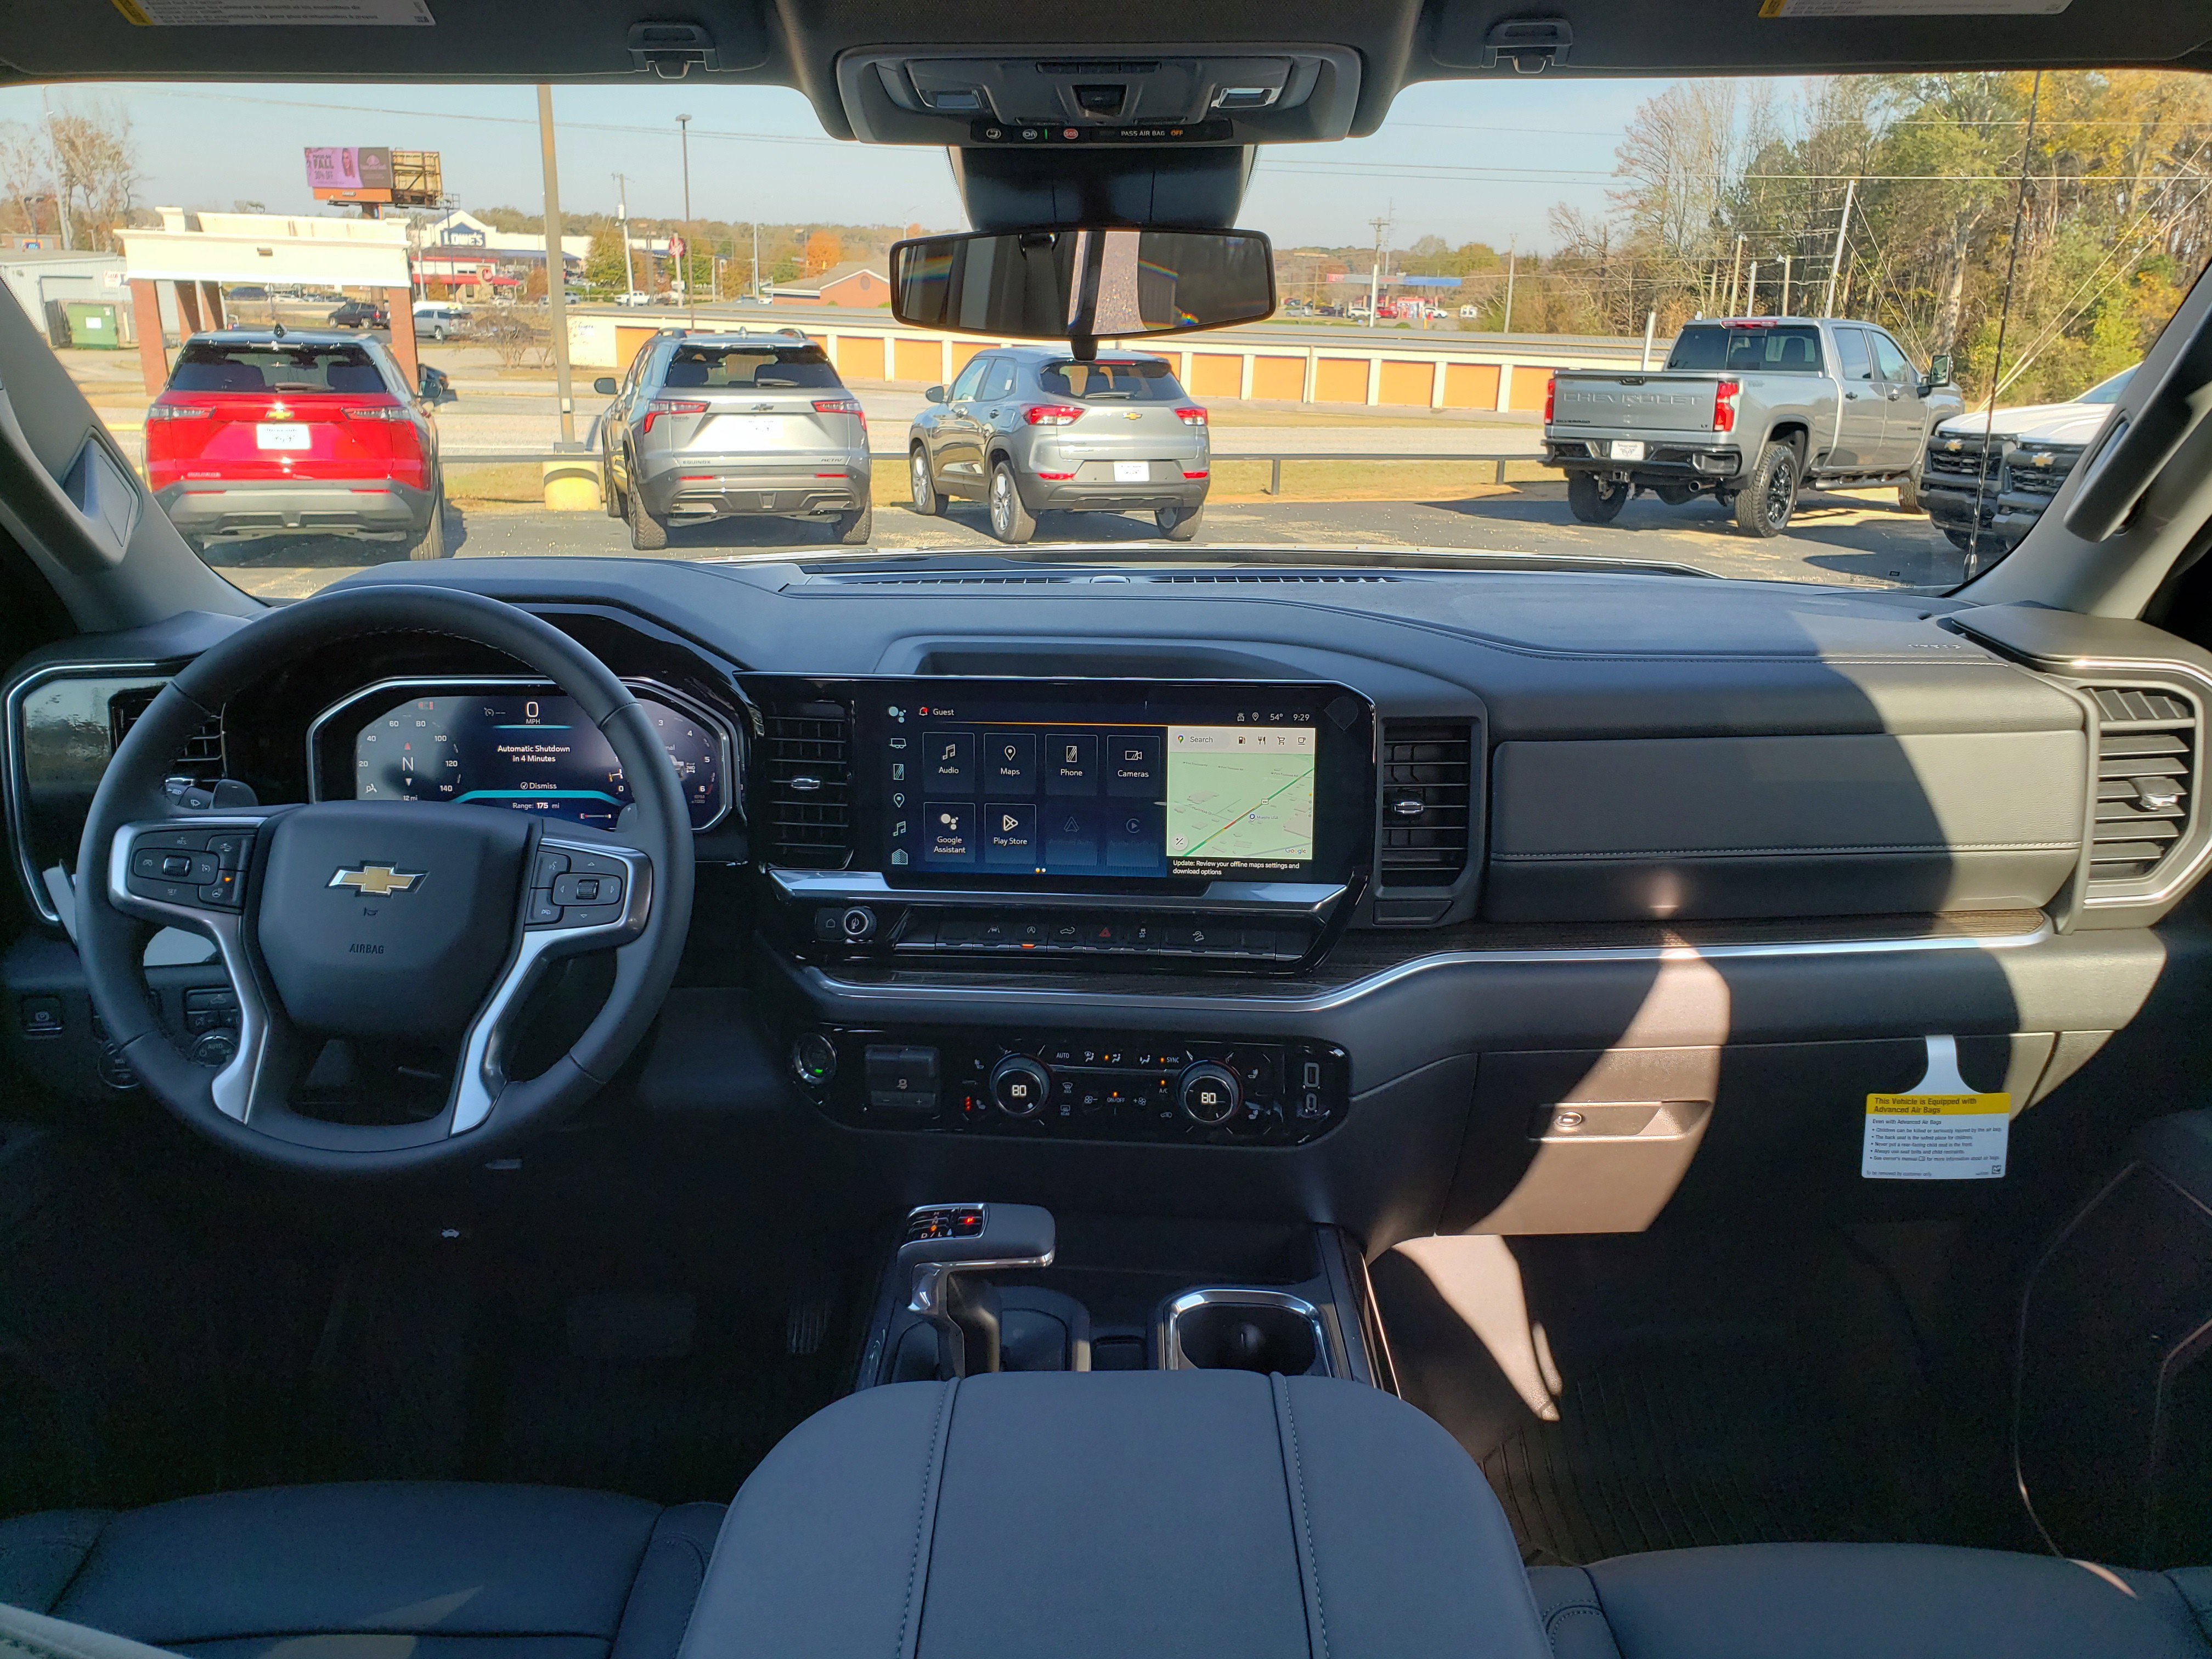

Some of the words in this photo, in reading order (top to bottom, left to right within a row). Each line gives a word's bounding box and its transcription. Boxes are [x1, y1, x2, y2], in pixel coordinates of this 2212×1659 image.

[314, 159, 334, 169] FALL
[1564, 393, 1703, 405] CHEVROLET
[527, 701, 539, 718] 0
[1270, 713, 1283, 721] 54°
[1293, 713, 1310, 721] 9:29
[402, 757, 414, 771] N
[938, 766, 960, 775] Audio
[1000, 768, 1020, 776] Maps
[1118, 770, 1149, 778] Cameras
[937, 836, 963, 845] Google
[994, 837, 1008, 846] Play
[1009, 837, 1028, 845] Store
[933, 845, 966, 854] Assistant
[348, 943, 385, 954] AIRBAG
[1012, 1085, 1027, 1097] 80
[1201, 1092, 1216, 1104] 80
[1927, 1098, 1960, 1106] Equipped
[1923, 1106, 1941, 1114] Bags
